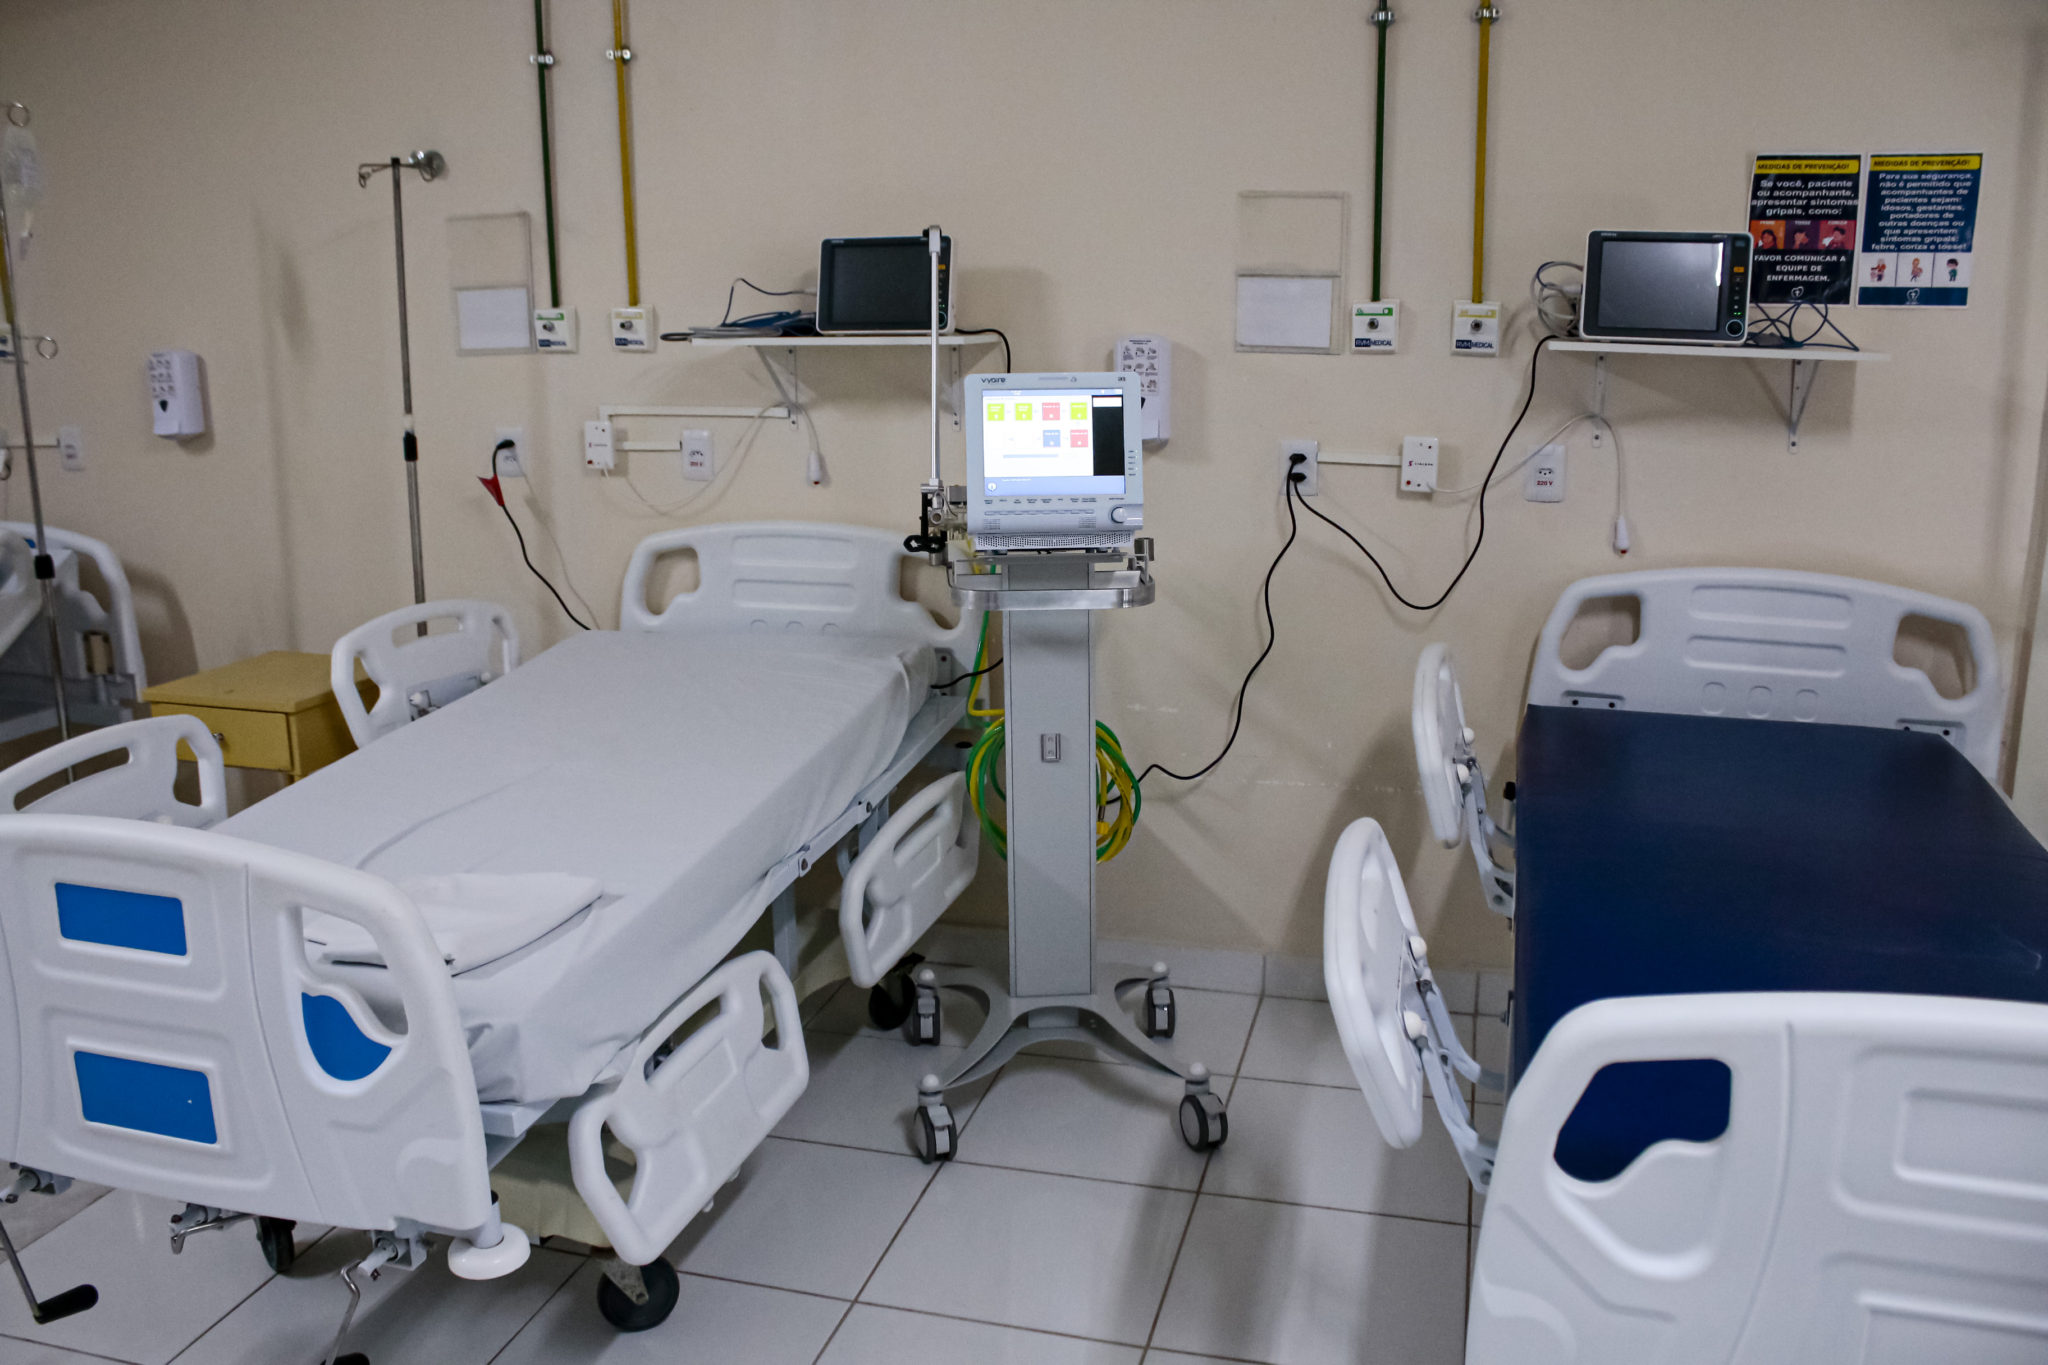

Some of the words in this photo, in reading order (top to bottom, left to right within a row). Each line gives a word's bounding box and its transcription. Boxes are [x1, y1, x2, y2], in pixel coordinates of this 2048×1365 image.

[1776, 180, 1805, 188] você,
[1807, 180, 1853, 189] paciente
[1906, 180, 1951, 188] permitido
[1773, 189, 1855, 198] acompanhante,
[1751, 199, 1807, 208] apresentar
[1766, 207, 1805, 216] gripais,
[1884, 228, 1901, 236] que
